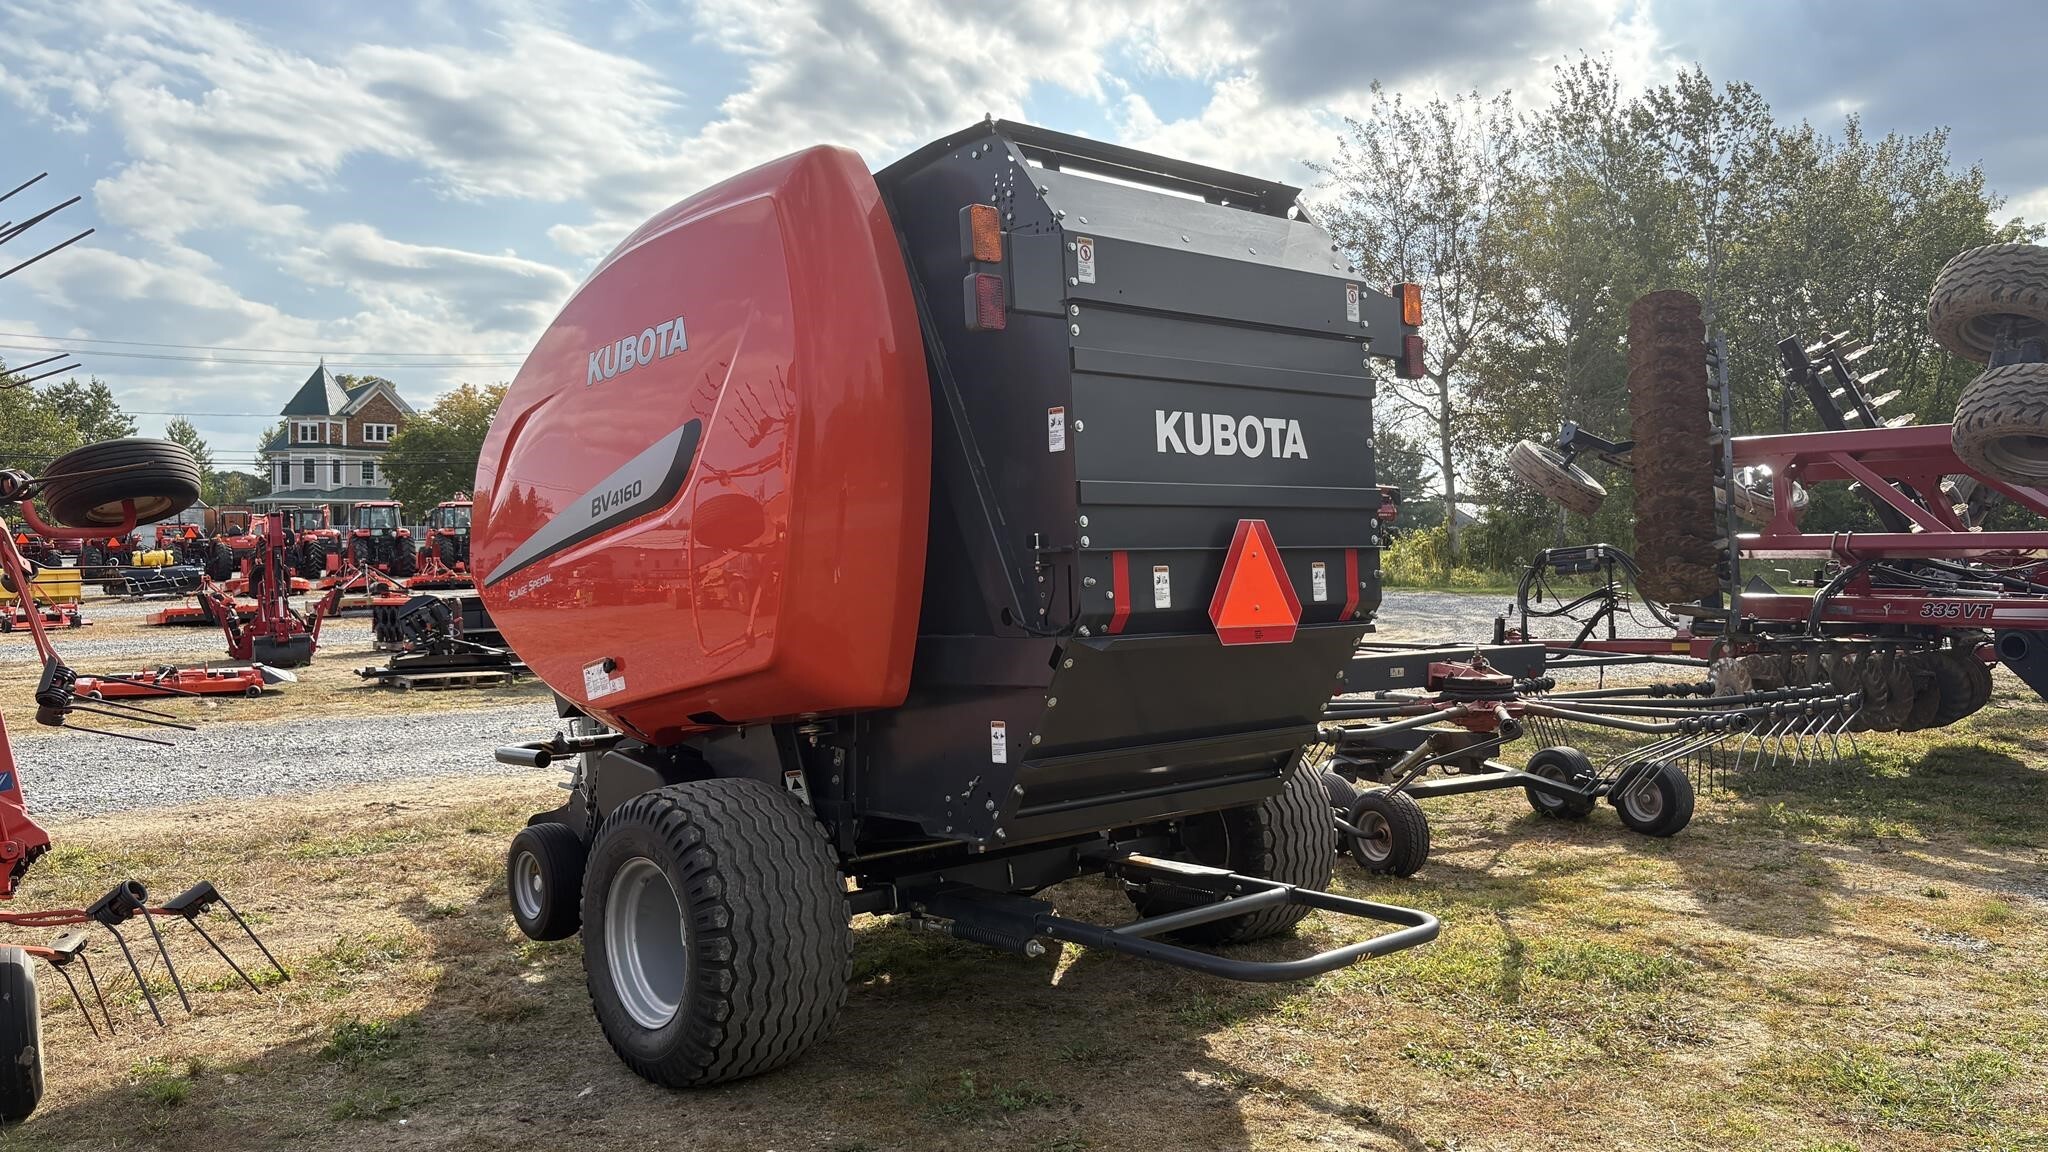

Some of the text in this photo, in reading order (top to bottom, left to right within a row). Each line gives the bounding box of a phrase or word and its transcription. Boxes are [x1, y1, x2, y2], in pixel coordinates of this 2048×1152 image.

[587, 315, 688, 386] KUBOTA
[1155, 410, 1308, 459] KUBOTA
[591, 480, 642, 518] BV4160
[1920, 602, 1993, 619] 335 VT
